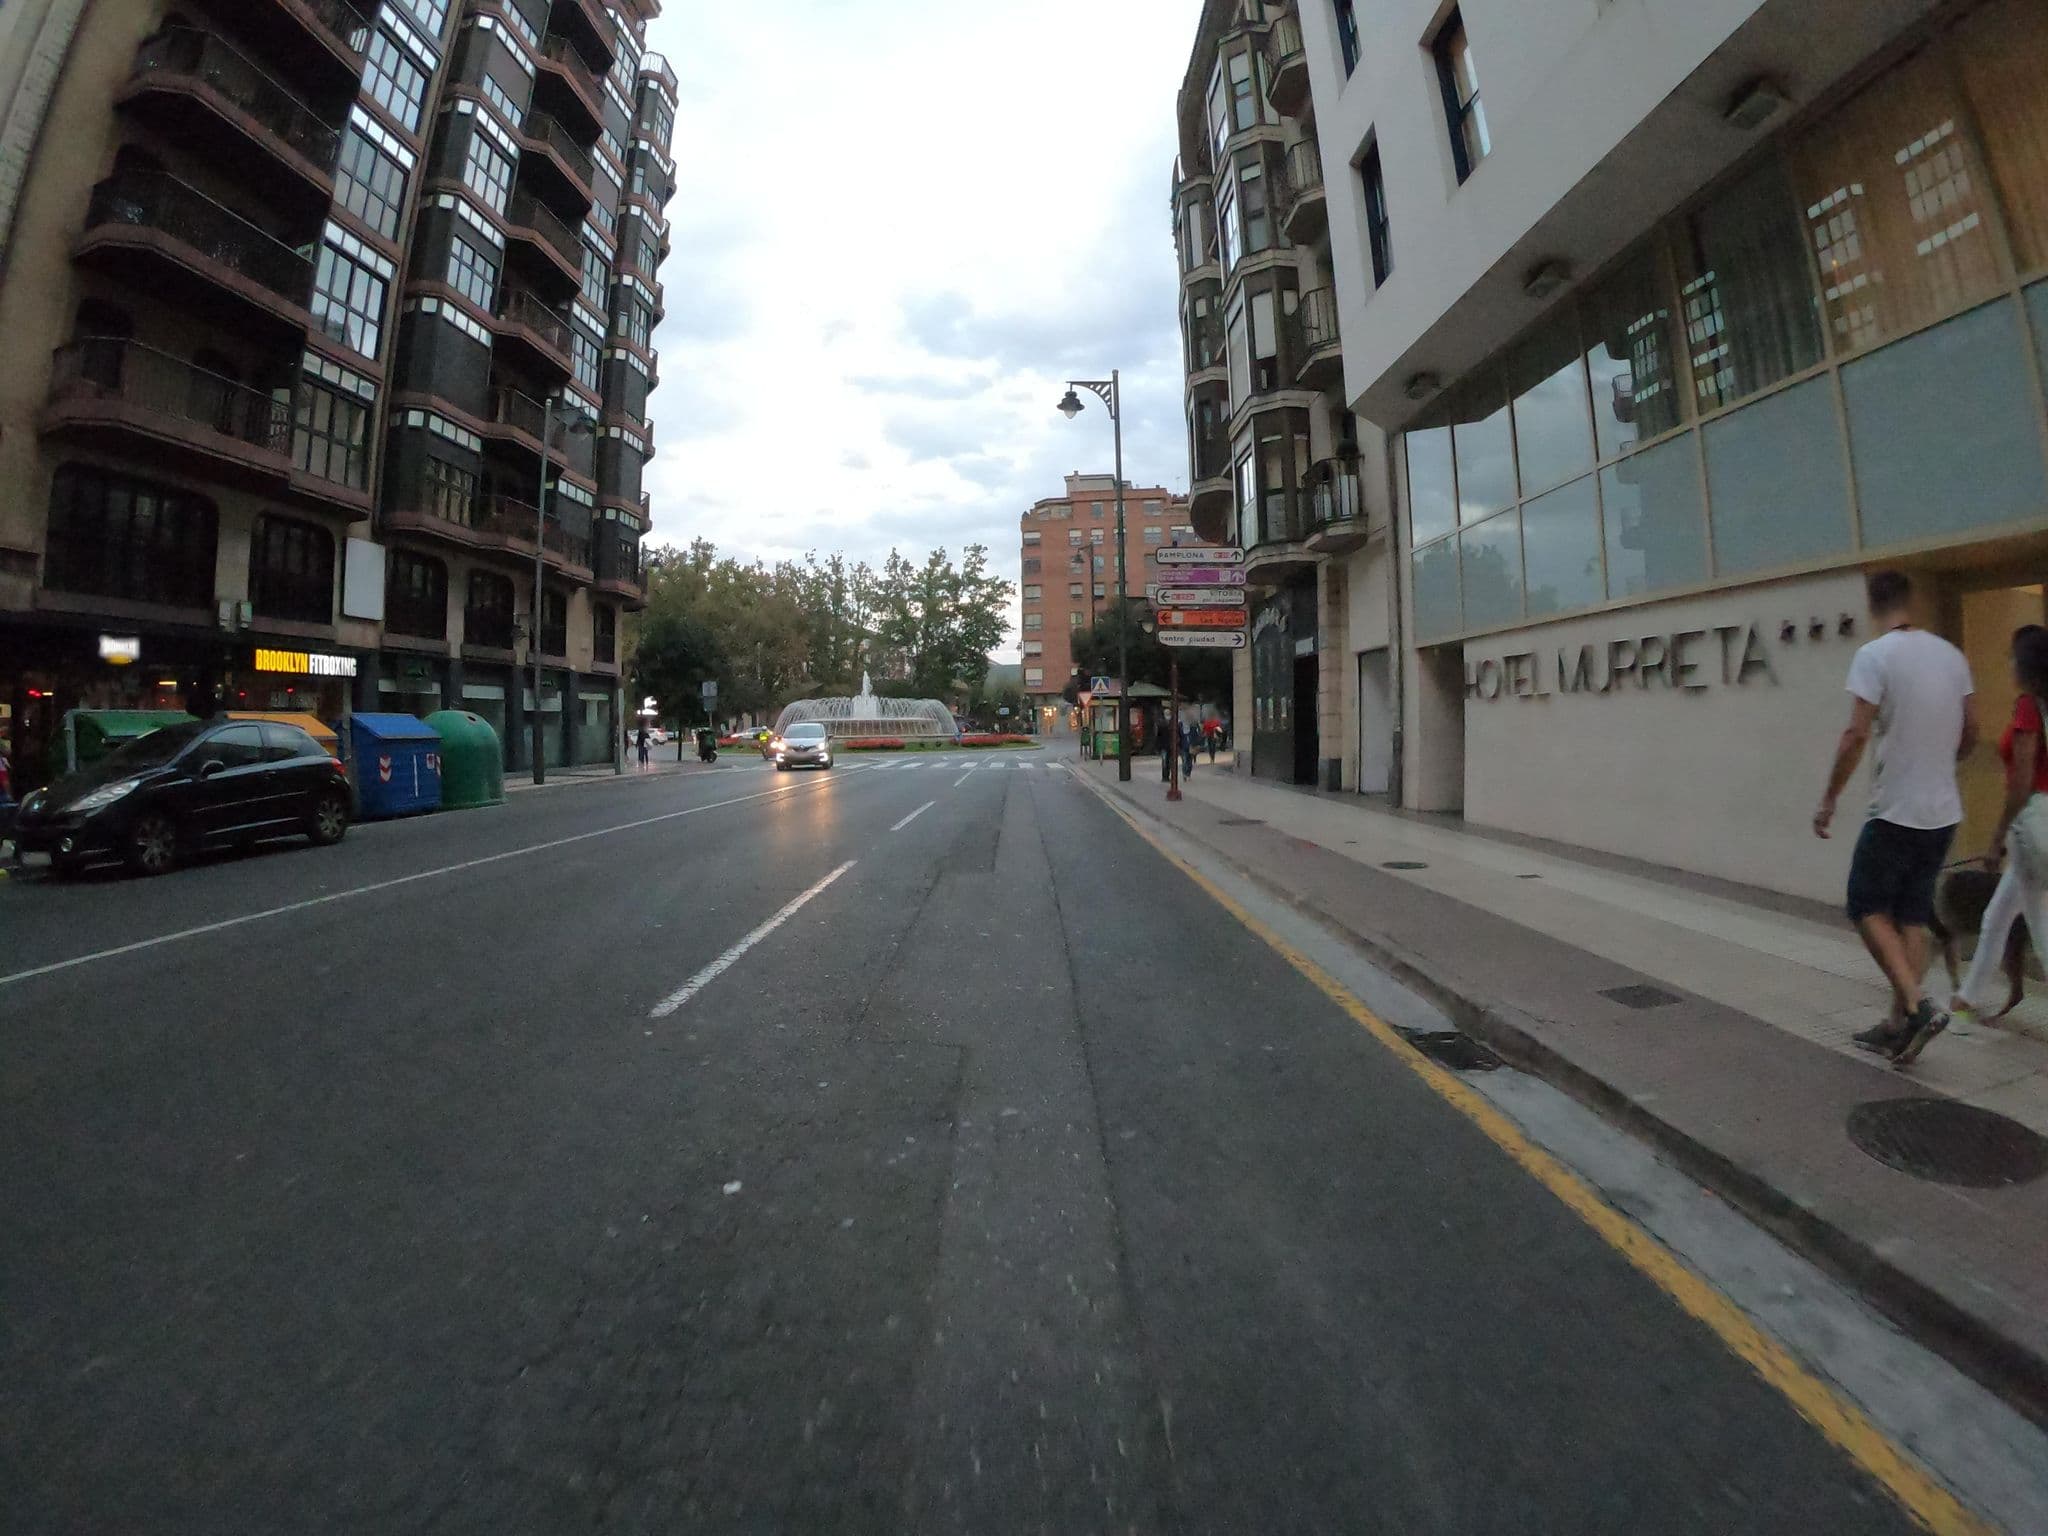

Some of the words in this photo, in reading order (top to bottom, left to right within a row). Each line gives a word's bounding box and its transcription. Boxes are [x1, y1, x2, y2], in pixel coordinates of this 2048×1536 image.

[1210, 590, 1243, 598] VTORIA
[255, 648, 308, 674] BROOKLYN
[309, 653, 357, 677] FITBOXING
[1464, 652, 1551, 703] HOTEL
